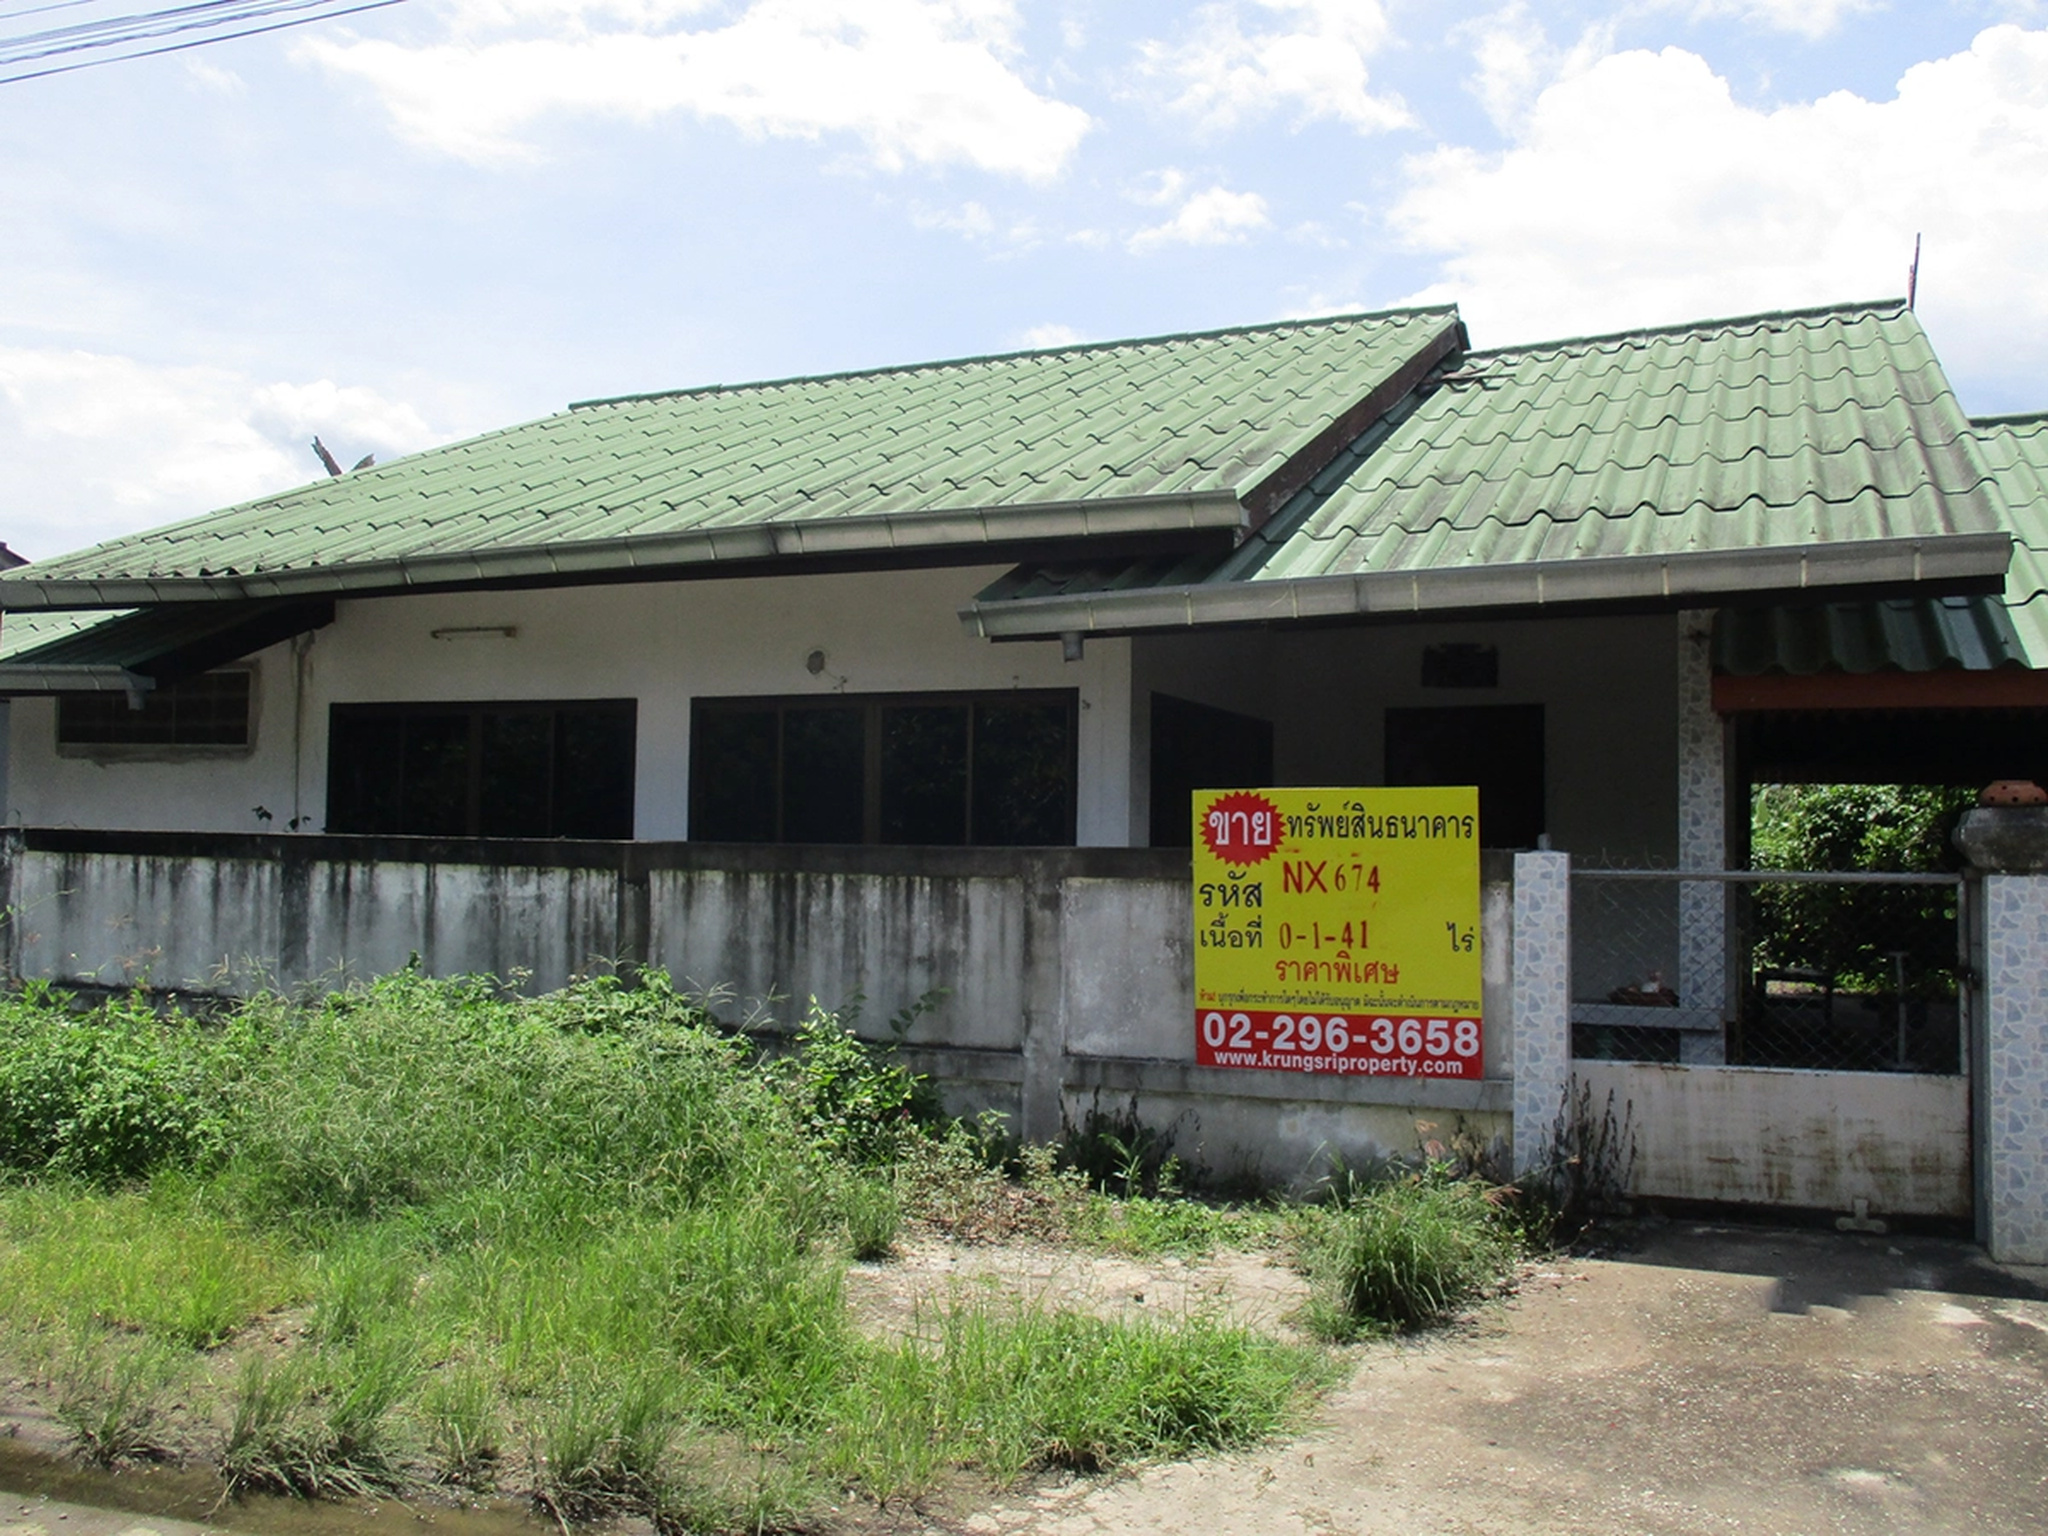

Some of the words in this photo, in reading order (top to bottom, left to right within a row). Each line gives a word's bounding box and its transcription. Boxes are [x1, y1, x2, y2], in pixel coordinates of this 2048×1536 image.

[1208, 811, 1272, 846] ขาย
[1286, 801, 1475, 839] ทรัพย์สินธนาคาร
[1199, 870, 1263, 908] รหัส
[1200, 912, 1263, 948] เนื้อที่
[1446, 921, 1475, 952] ไร่
[1275, 950, 1400, 984] ราคาพิเศษ
[1203, 1012, 1480, 1057] 02-296-3658
[1214, 1050, 1464, 1075] www.krungsriproperty.com
